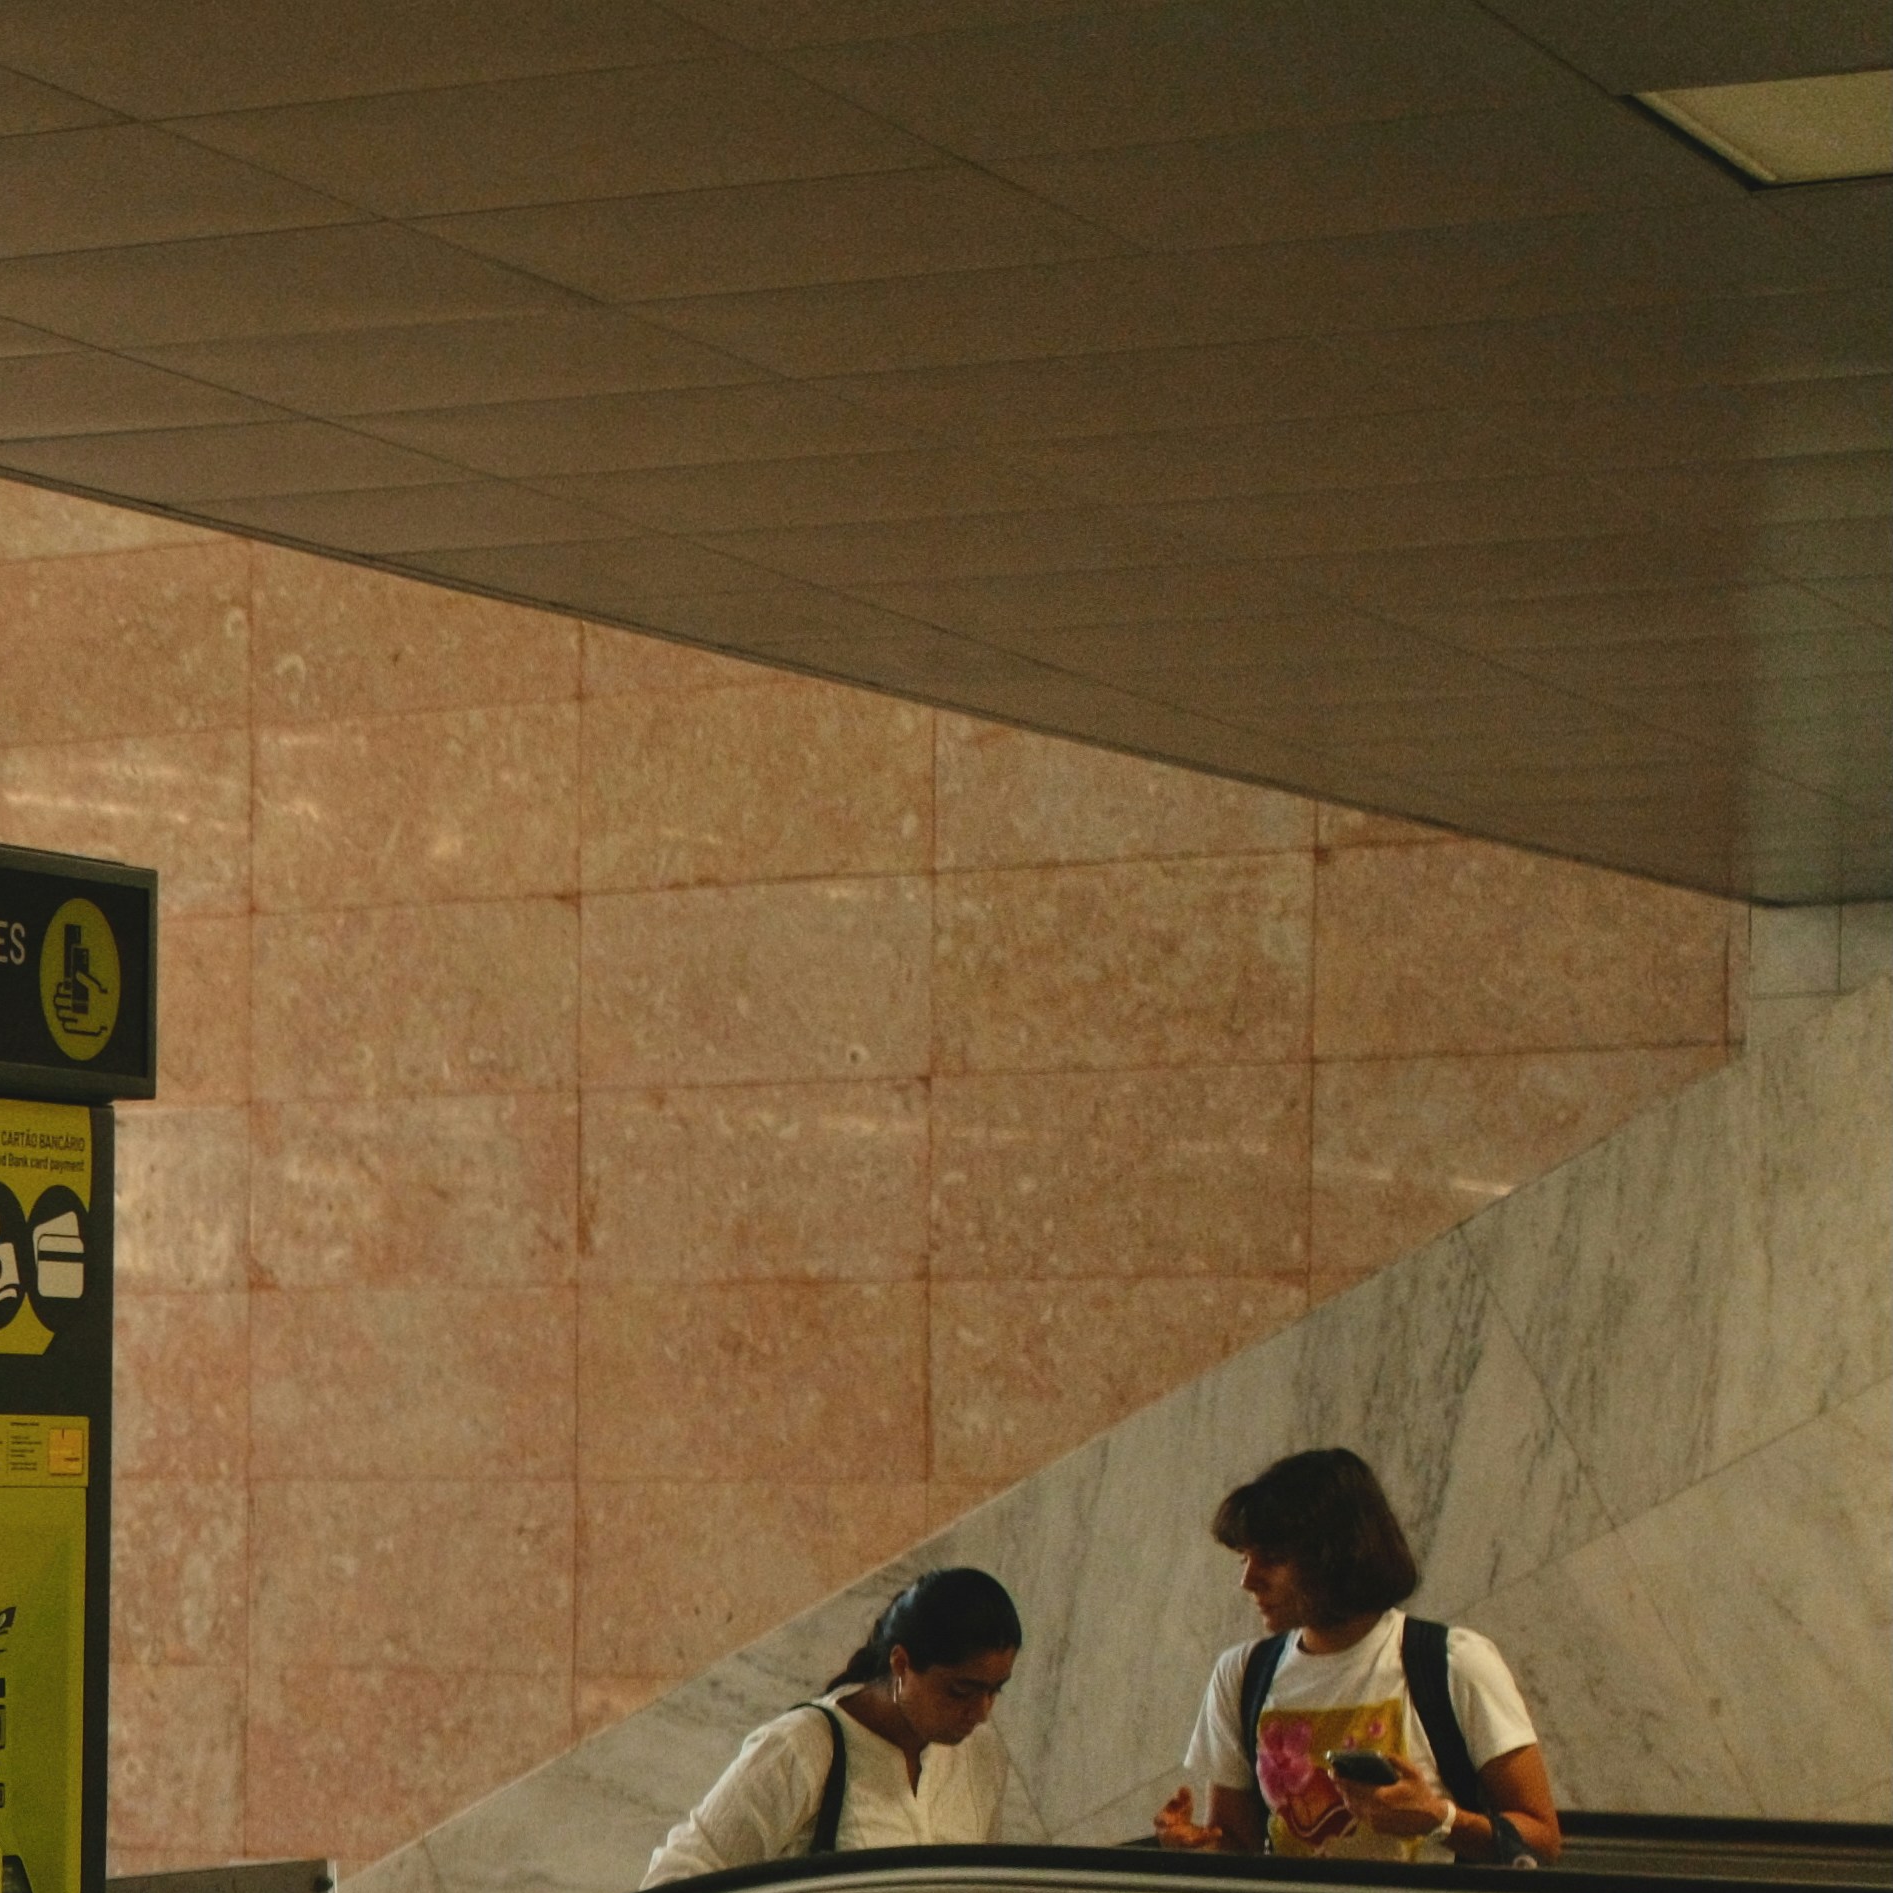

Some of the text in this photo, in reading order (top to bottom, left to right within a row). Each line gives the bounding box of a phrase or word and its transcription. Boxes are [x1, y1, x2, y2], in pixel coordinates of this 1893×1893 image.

[1, 1129, 37, 1148] CARTÃO
[30, 1156, 48, 1169] card
[50, 1158, 84, 1174] payment
